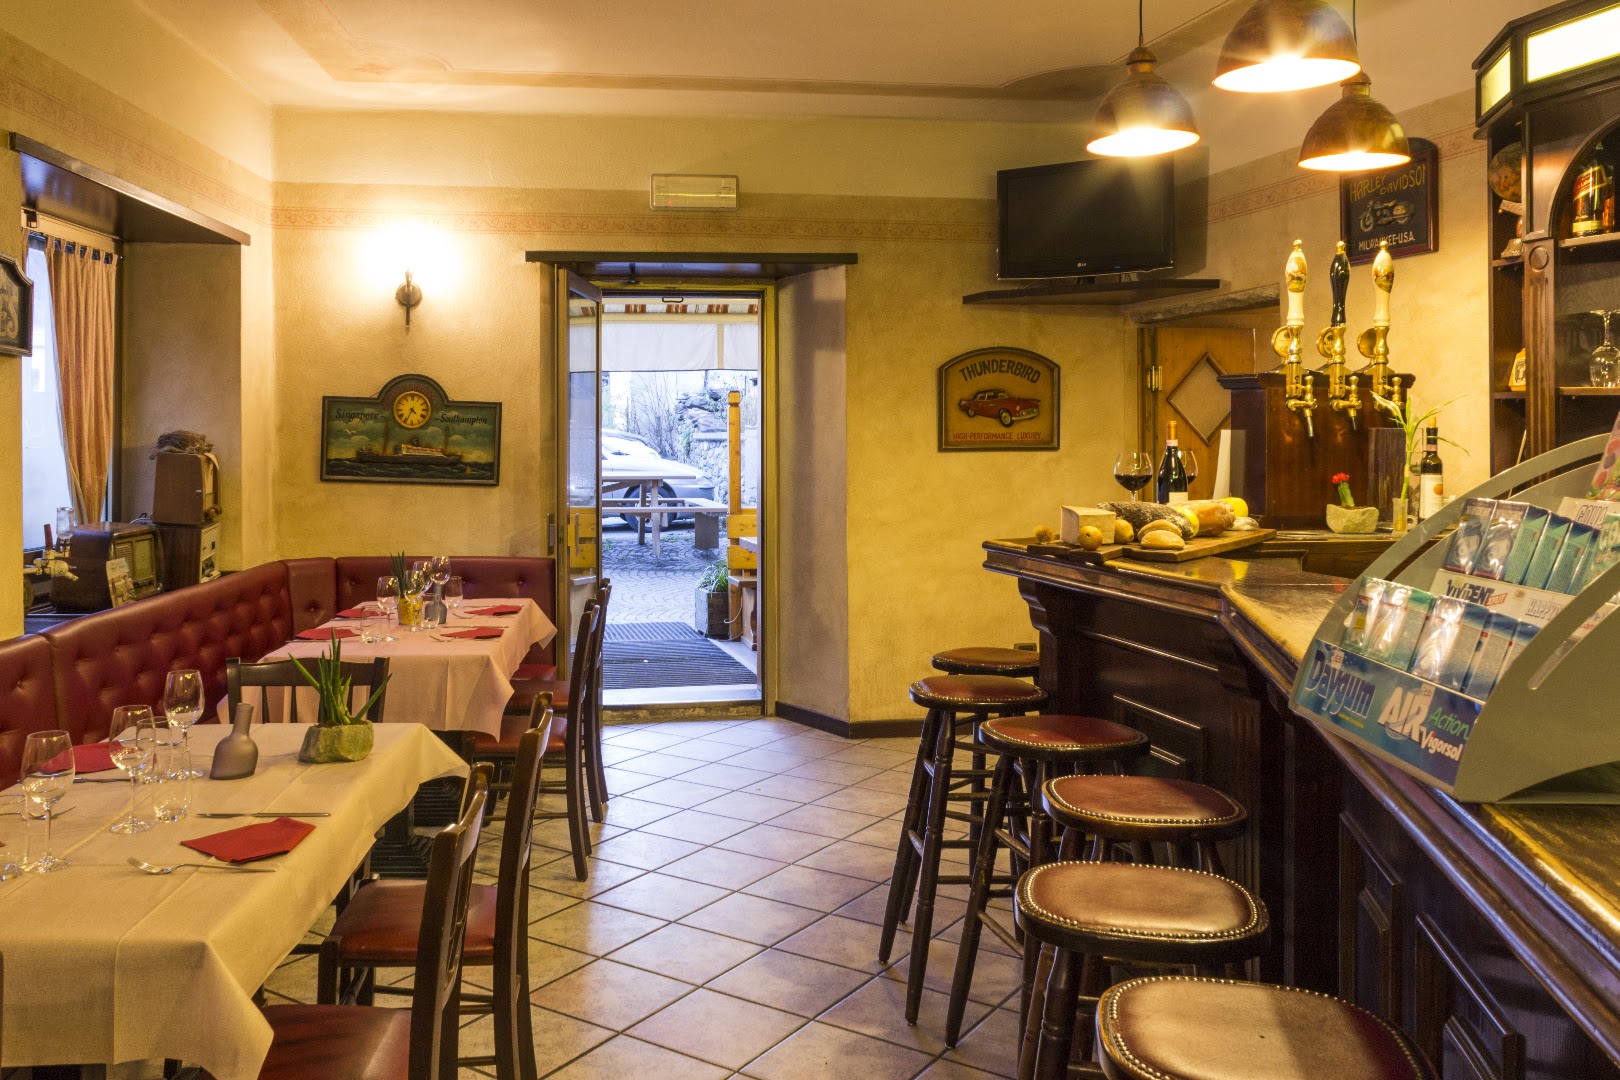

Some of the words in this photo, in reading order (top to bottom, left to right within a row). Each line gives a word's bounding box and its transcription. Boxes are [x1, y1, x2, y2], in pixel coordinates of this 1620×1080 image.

[1349, 174, 1386, 202] HARLEY
[959, 359, 1041, 384] THUNDERBIRD
[335, 408, 379, 422] Singapore
[439, 413, 488, 425] Southampton
[952, 431, 1013, 440] HIGH-PERFORMANCE
[1017, 431, 1042, 440] LUXURY
[1304, 649, 1376, 719] Daygum
[1377, 686, 1433, 742] AIR
[1427, 706, 1470, 740] Action
[1419, 726, 1464, 762] Vigorsol
